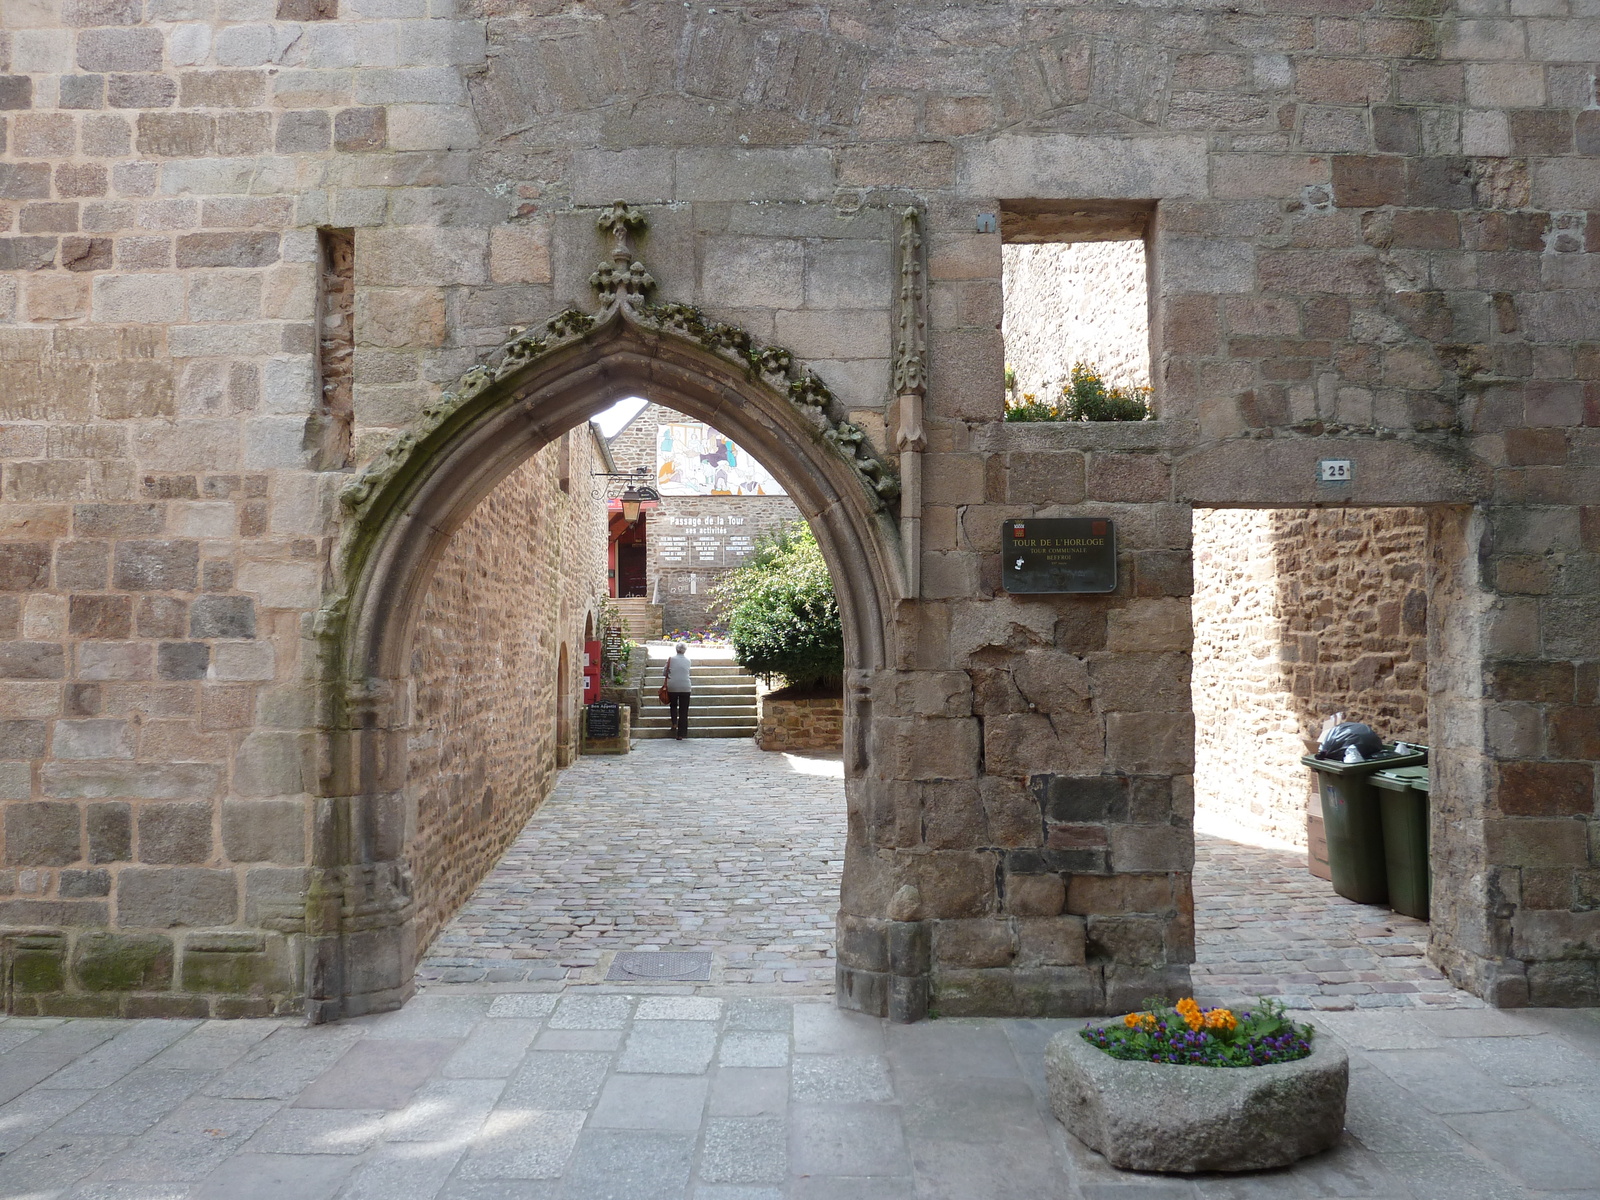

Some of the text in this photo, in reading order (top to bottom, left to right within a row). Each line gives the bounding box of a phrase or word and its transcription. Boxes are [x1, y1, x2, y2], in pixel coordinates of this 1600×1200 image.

[1328, 465, 1345, 476] 25
[669, 516, 744, 526] Passage de la Tour
[1013, 539, 1037, 547] TOUR
[1055, 538, 1105, 546] L'HORLOGE
